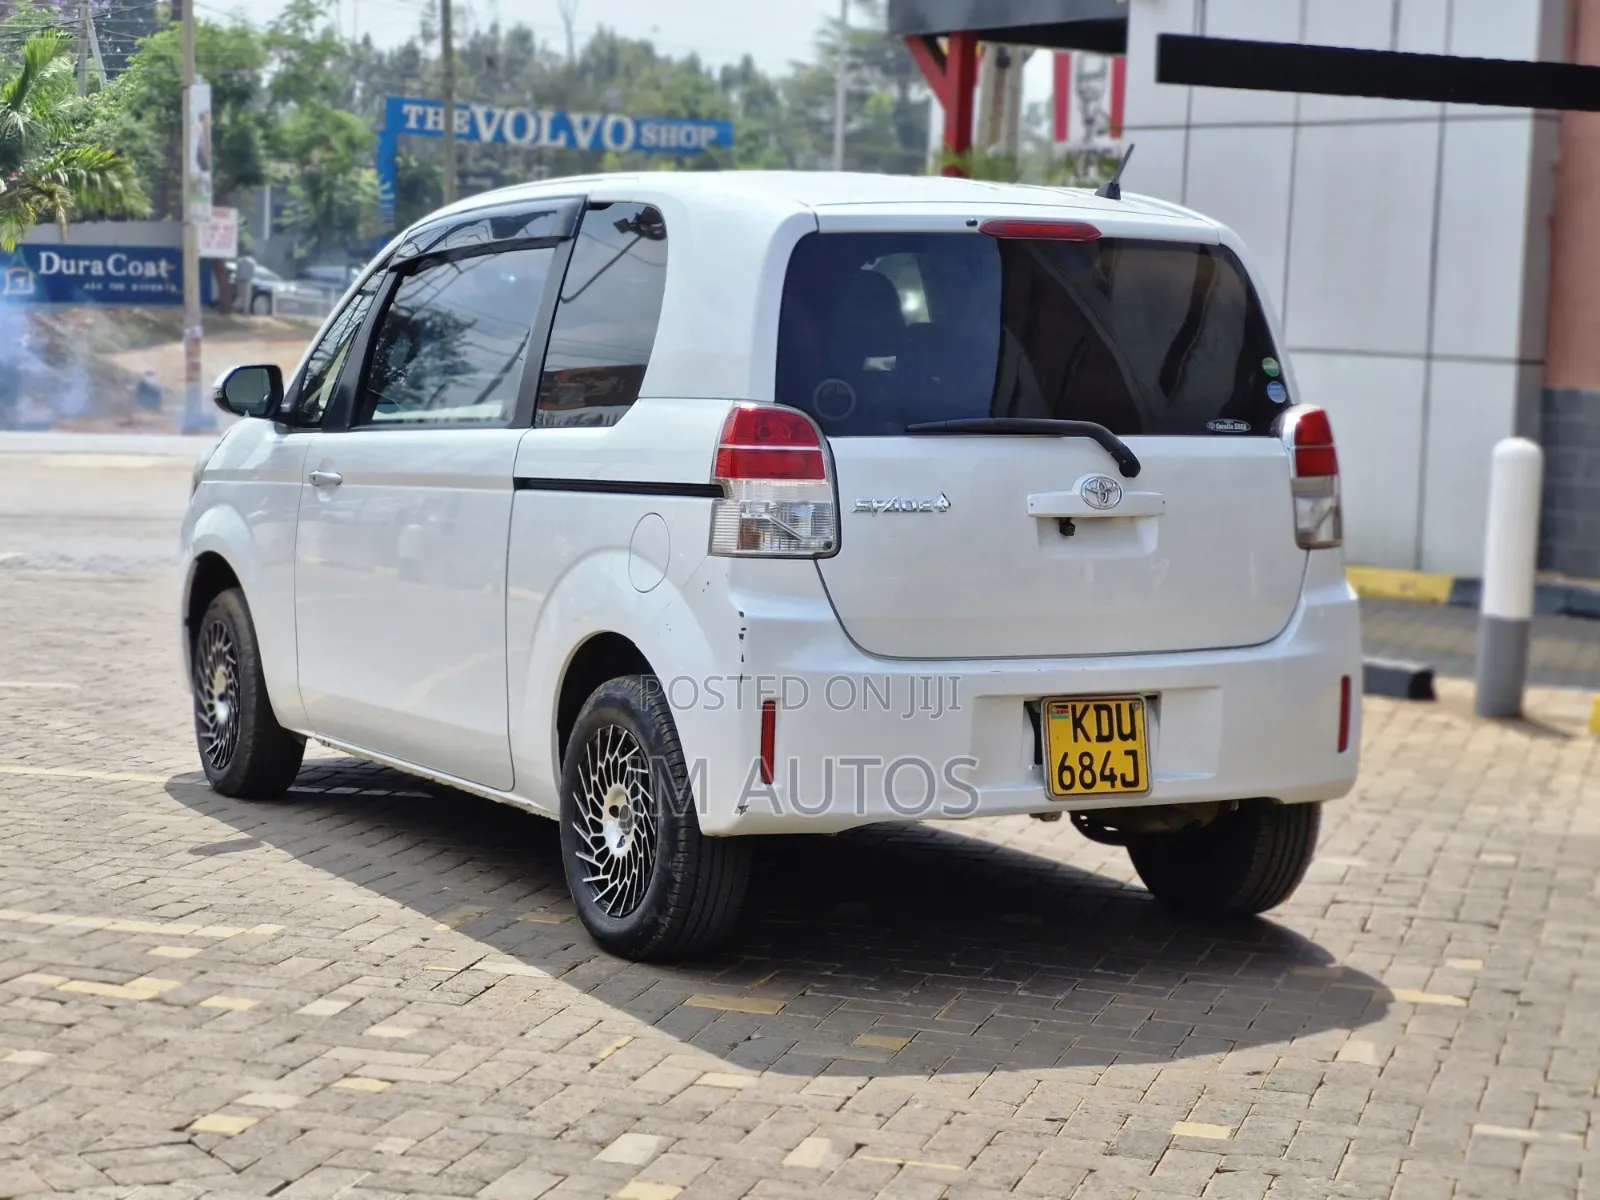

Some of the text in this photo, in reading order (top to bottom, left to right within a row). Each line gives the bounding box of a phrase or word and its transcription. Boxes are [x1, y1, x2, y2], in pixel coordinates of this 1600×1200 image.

[402, 104, 717, 151] THE VOLVO SHOP
[851, 496, 934, 517] SPADE
[1070, 703, 1137, 743] KDU
[1057, 749, 1140, 791] 684J
